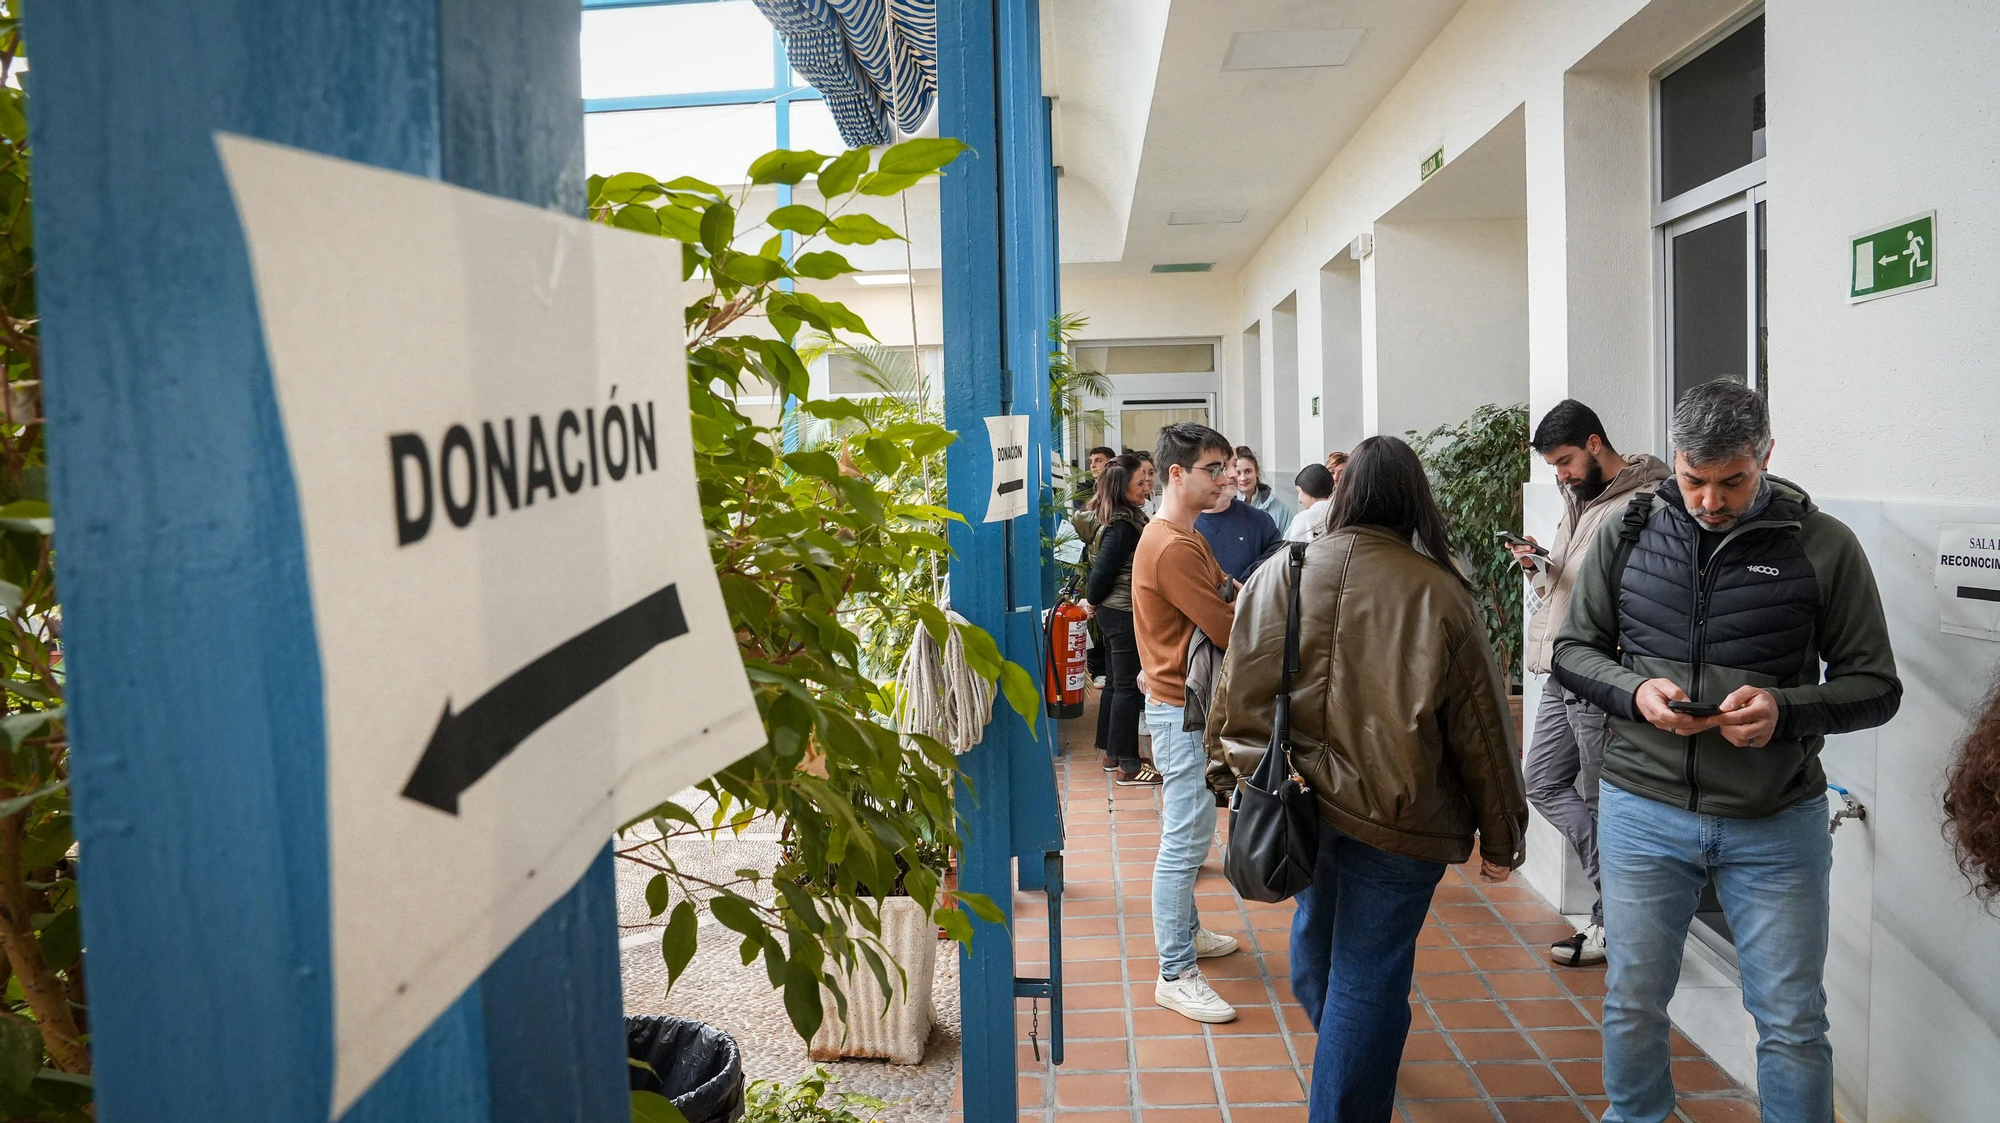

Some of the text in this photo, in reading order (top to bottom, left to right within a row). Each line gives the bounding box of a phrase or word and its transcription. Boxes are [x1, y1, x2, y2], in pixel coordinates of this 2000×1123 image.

[997, 443, 1023, 462] DONACIÓN
[389, 384, 657, 548] DONACIÓN
[1969, 538, 1995, 550] SALA
